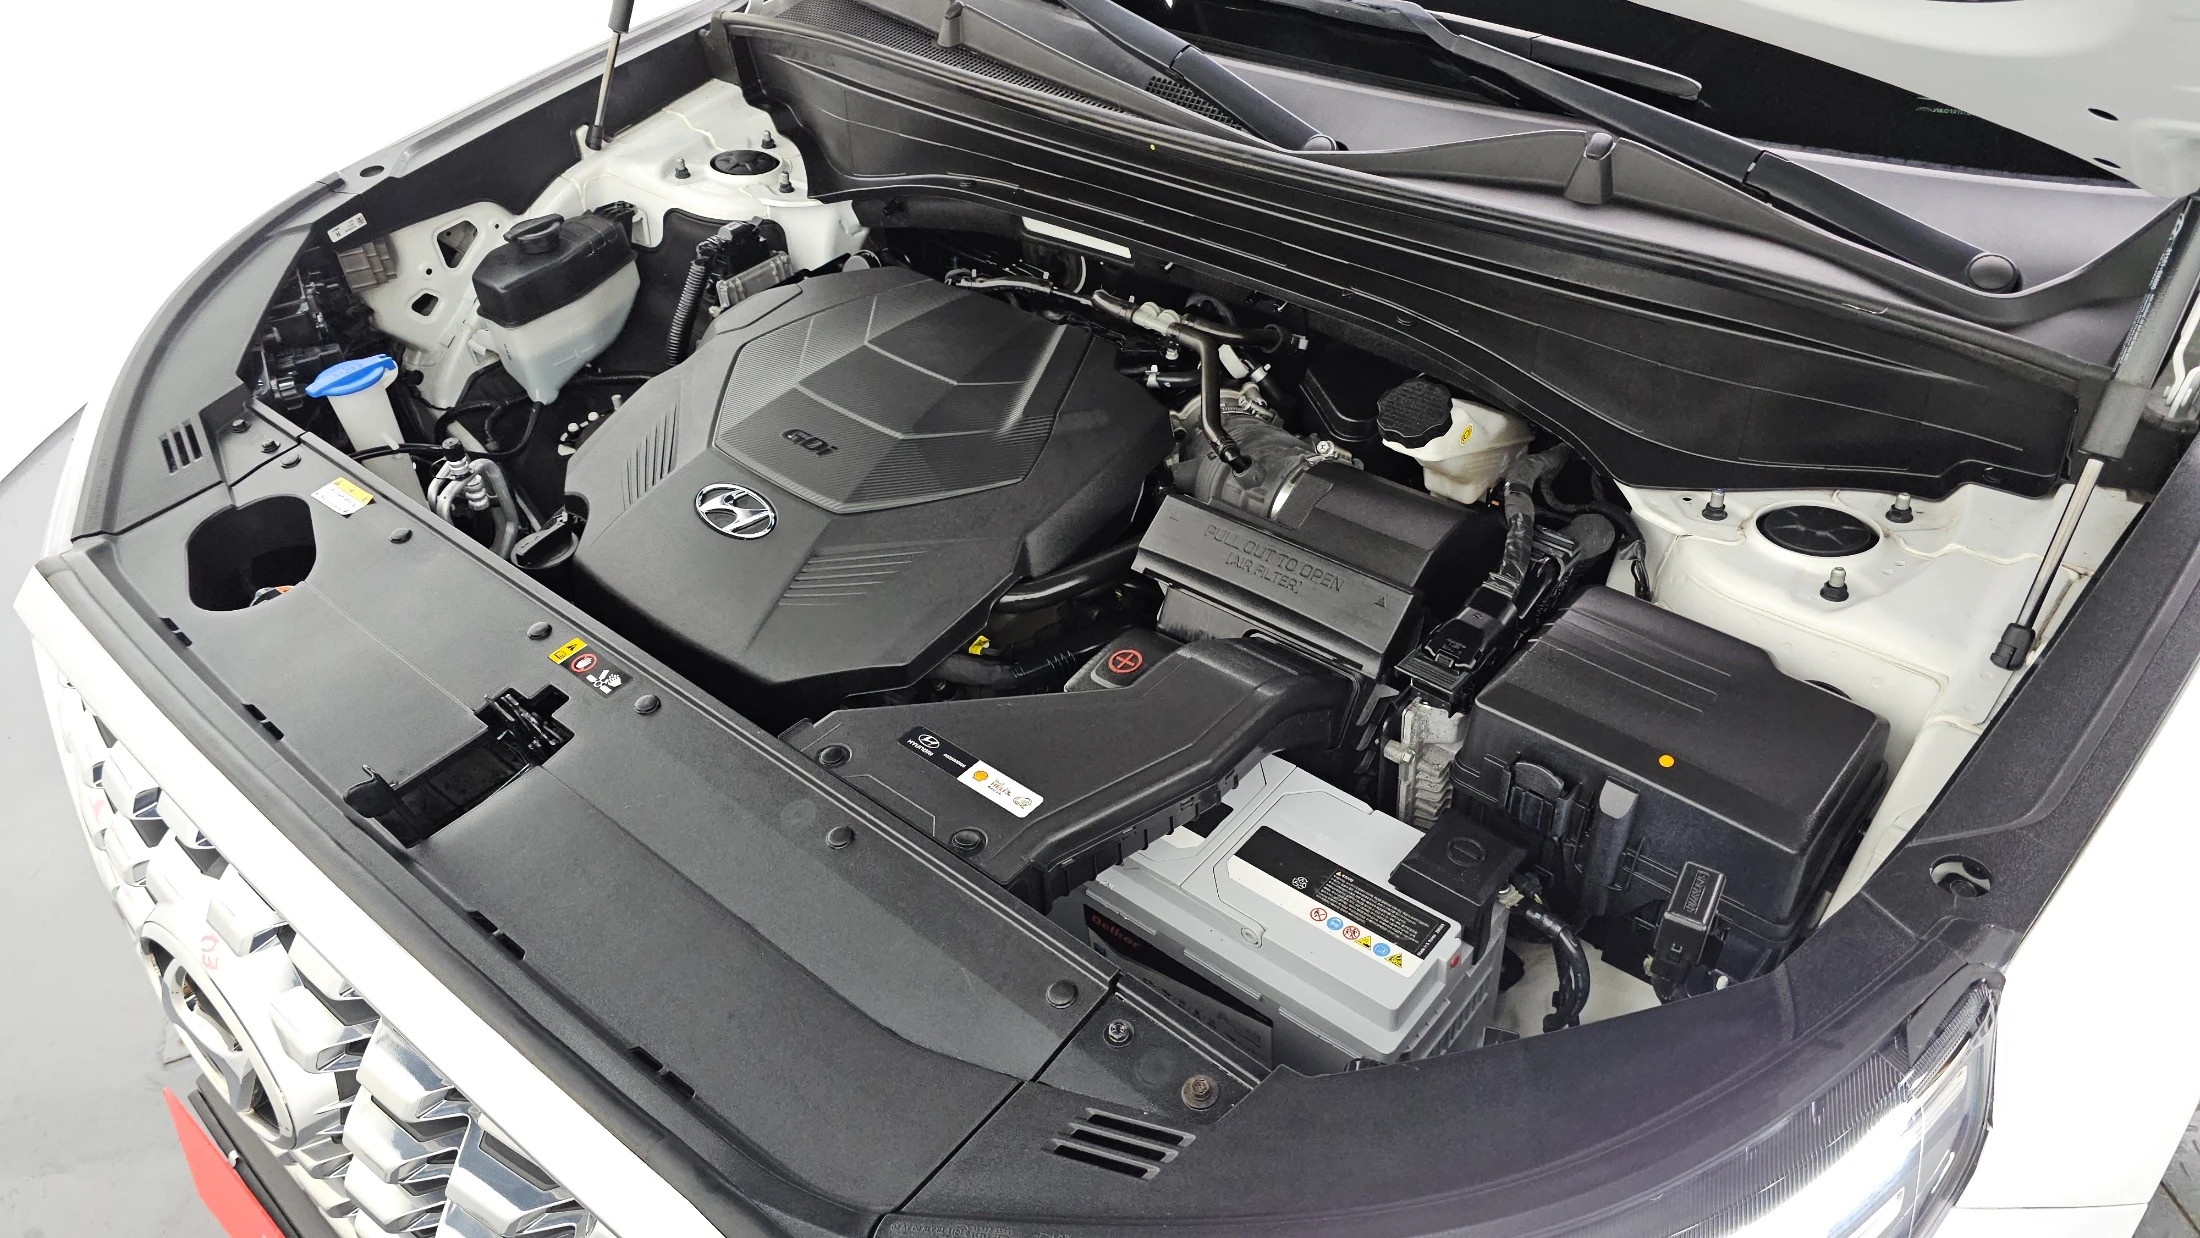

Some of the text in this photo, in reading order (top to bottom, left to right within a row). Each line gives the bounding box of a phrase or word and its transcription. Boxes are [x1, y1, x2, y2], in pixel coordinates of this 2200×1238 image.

[1204, 525, 1345, 592] PULL OUT TO OPEN
[907, 739, 934, 756] HYUNDAI
[1091, 913, 1140, 949] Delkor
